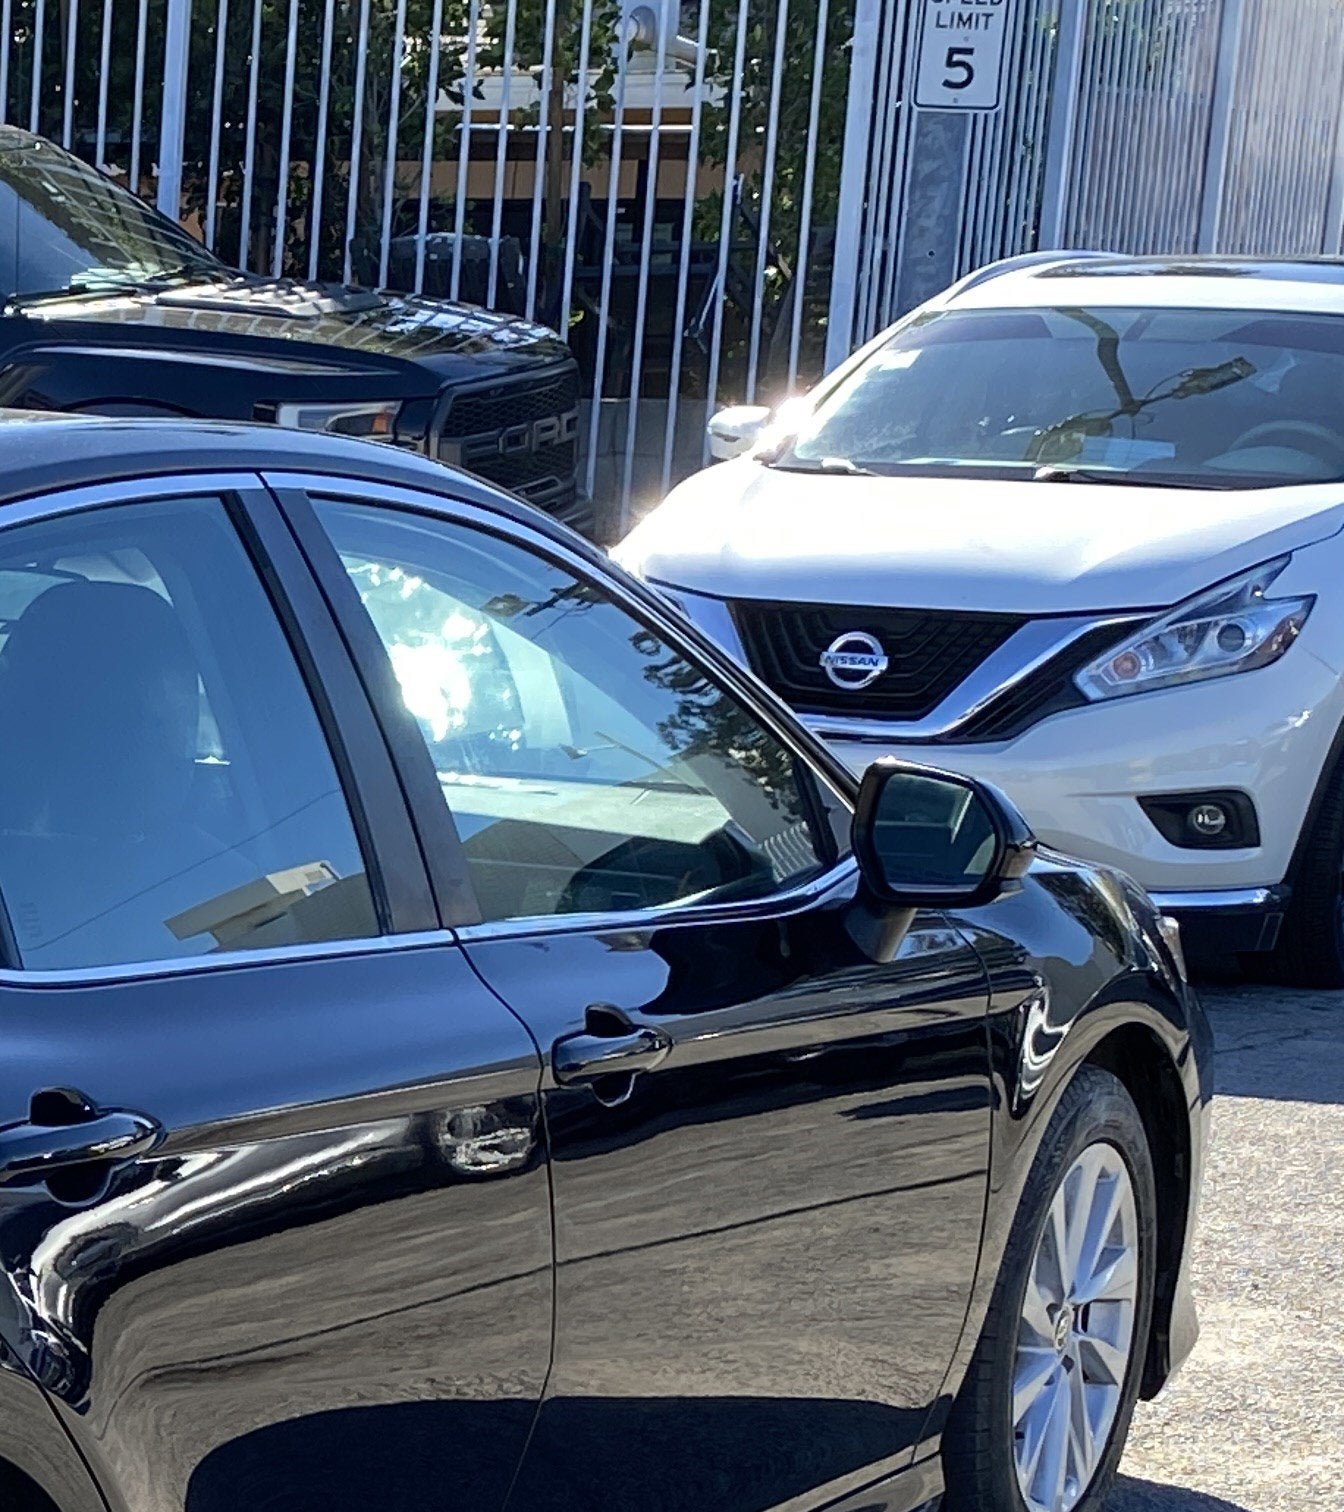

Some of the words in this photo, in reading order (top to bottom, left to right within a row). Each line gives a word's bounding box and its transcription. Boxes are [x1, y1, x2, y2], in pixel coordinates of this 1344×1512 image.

[935, 10, 994, 30] LIMIT
[941, 46, 975, 90] 5
[824, 655, 880, 667] NISSAN
